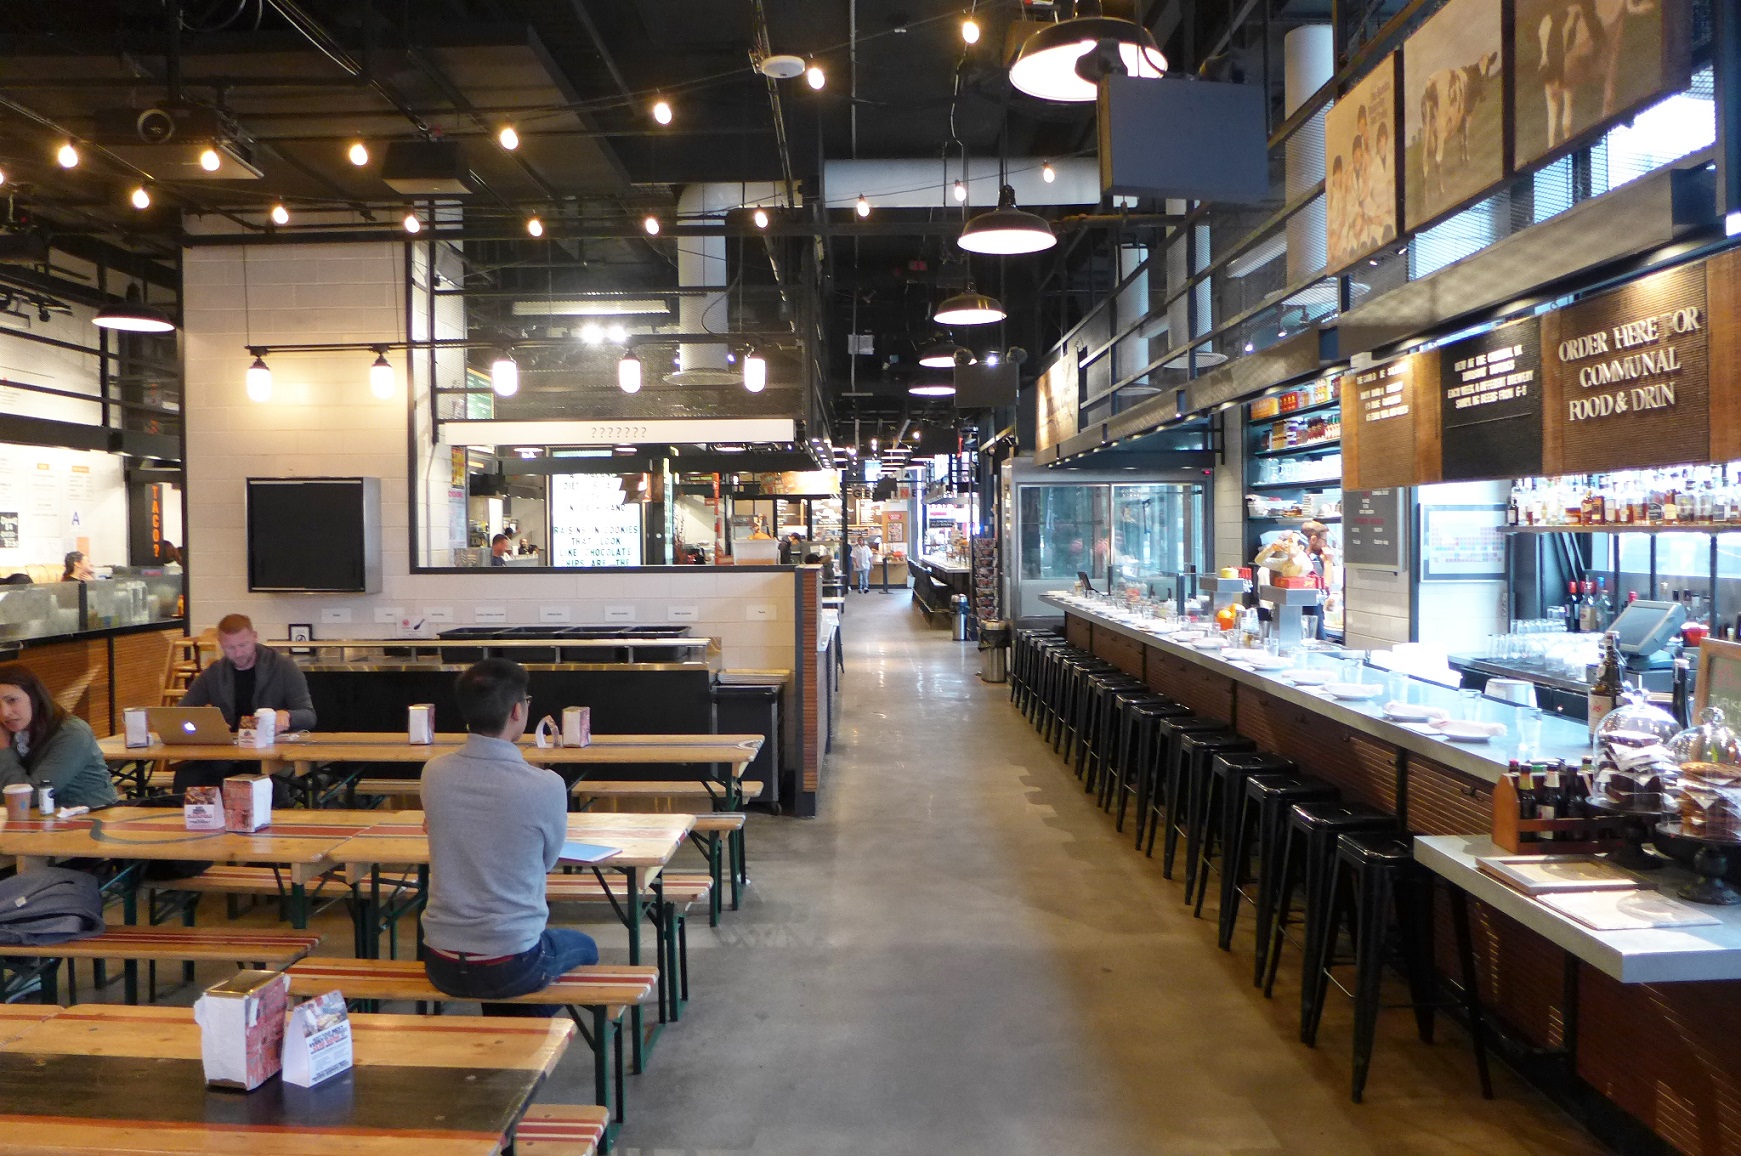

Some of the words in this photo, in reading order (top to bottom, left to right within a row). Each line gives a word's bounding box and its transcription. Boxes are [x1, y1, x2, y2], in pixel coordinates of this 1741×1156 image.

[1559, 331, 1609, 362] ORDER
[1612, 316, 1660, 349] HERE
[1660, 306, 1701, 337] FOR
[1579, 347, 1682, 387] COMMUNAL
[1569, 394, 1615, 421] FOOD
[1630, 381, 1676, 411] DRIN
[71, 511, 81, 526] A
[571, 537, 591, 546] THAT
[600, 537, 621, 546] LOOK
